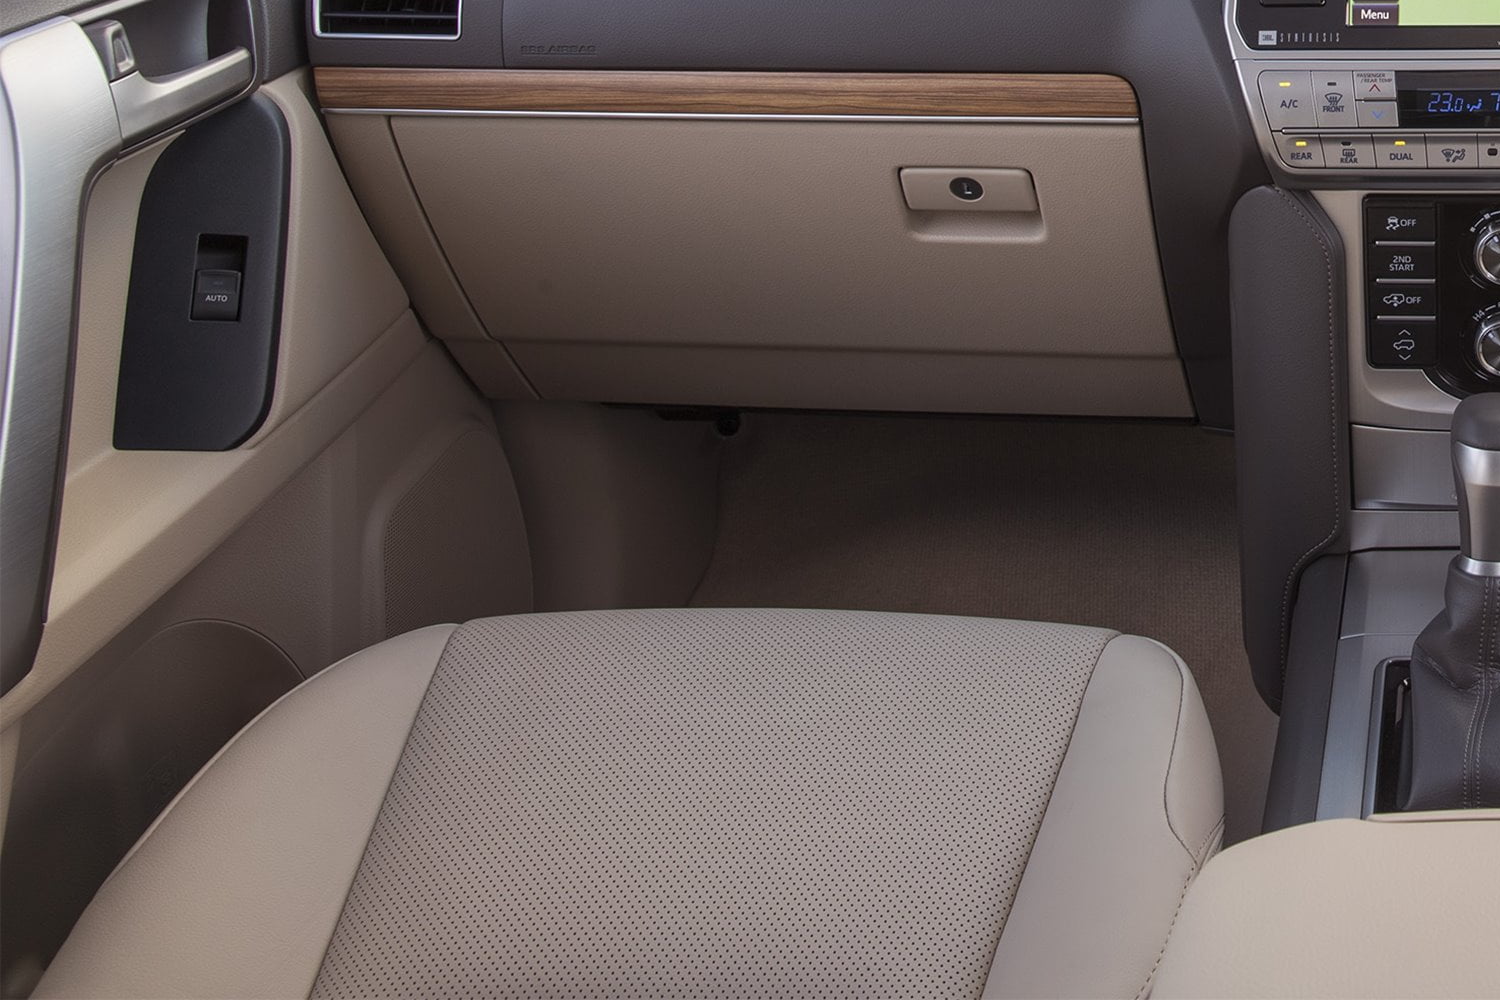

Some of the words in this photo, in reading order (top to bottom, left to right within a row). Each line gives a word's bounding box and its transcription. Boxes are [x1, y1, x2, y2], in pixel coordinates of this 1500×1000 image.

[1361, 9, 1389, 20] Menu
[1280, 100, 1298, 109] A/C
[1427, 92, 1463, 112] 23.0
[1322, 105, 1344, 113] FRONT
[1290, 152, 1312, 160] REAR
[1389, 153, 1413, 161] DUAL
[1400, 218, 1416, 228] OFF
[1393, 255, 1411, 264] 2ND
[1389, 263, 1415, 272] START
[205, 294, 228, 302] AUTO
[1406, 296, 1422, 304] OFF
[1472, 309, 1485, 322] H4
